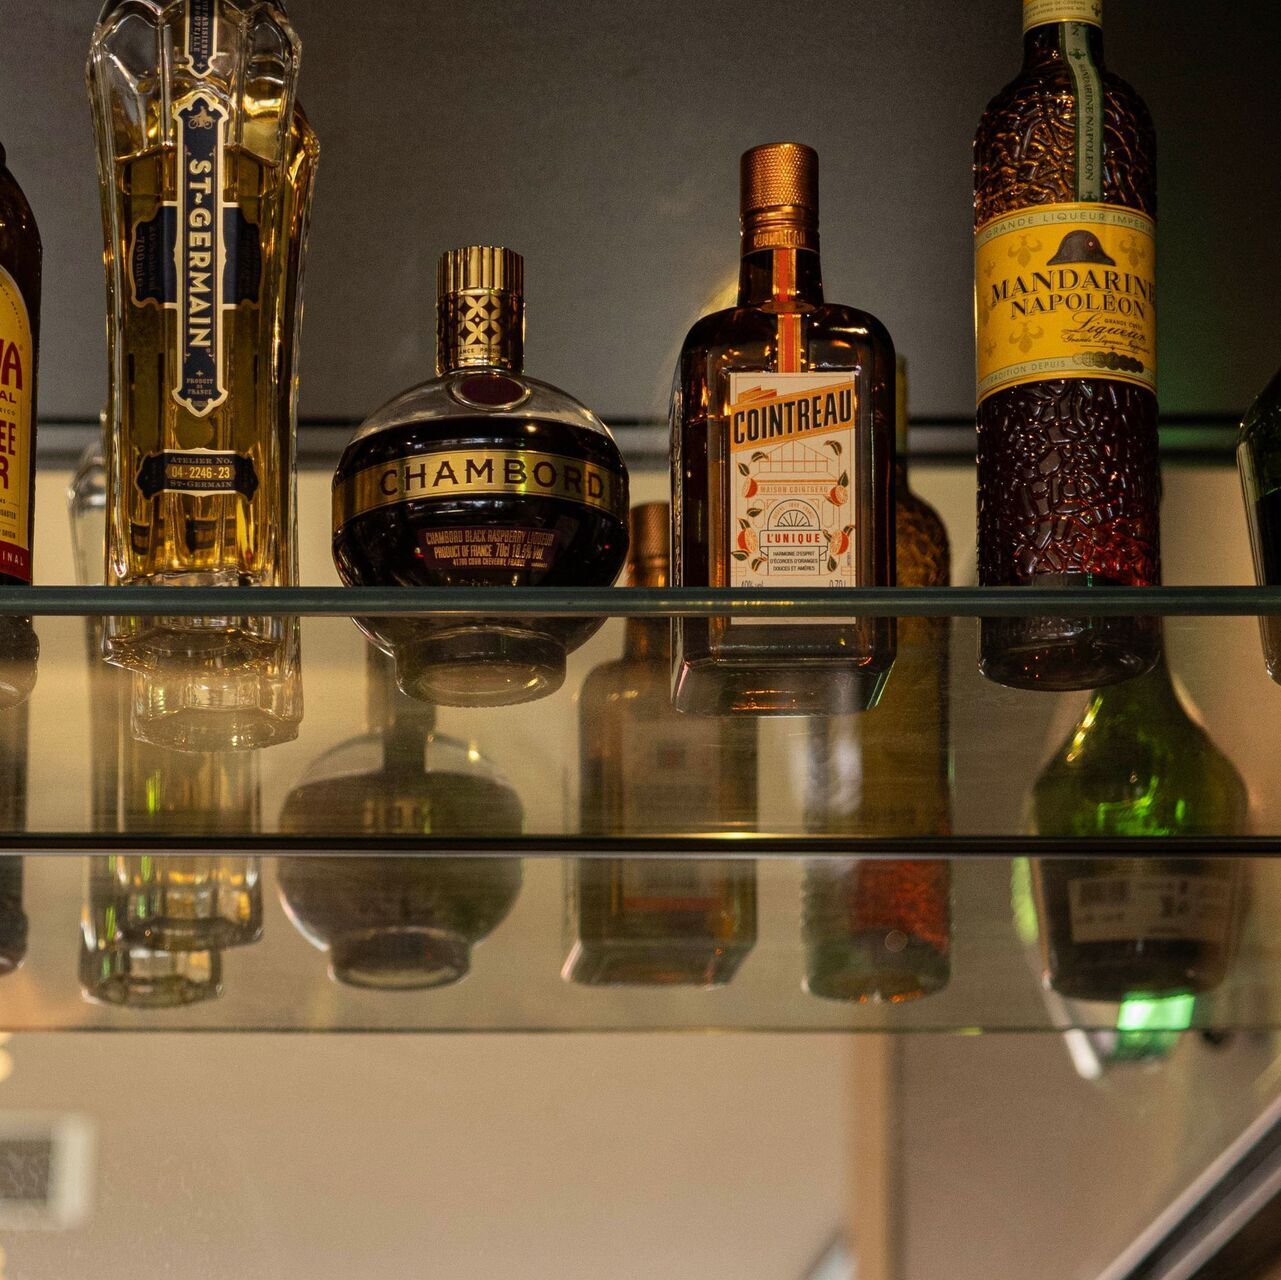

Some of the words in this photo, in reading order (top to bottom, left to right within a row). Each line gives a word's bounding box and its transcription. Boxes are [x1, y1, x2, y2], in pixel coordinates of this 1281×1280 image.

[1011, 289, 1146, 321] NAPOLÉON
[734, 389, 852, 444] COINTREAU
[379, 458, 604, 498] CHAMBORD
[767, 533, 820, 543] L'UNIQUE
